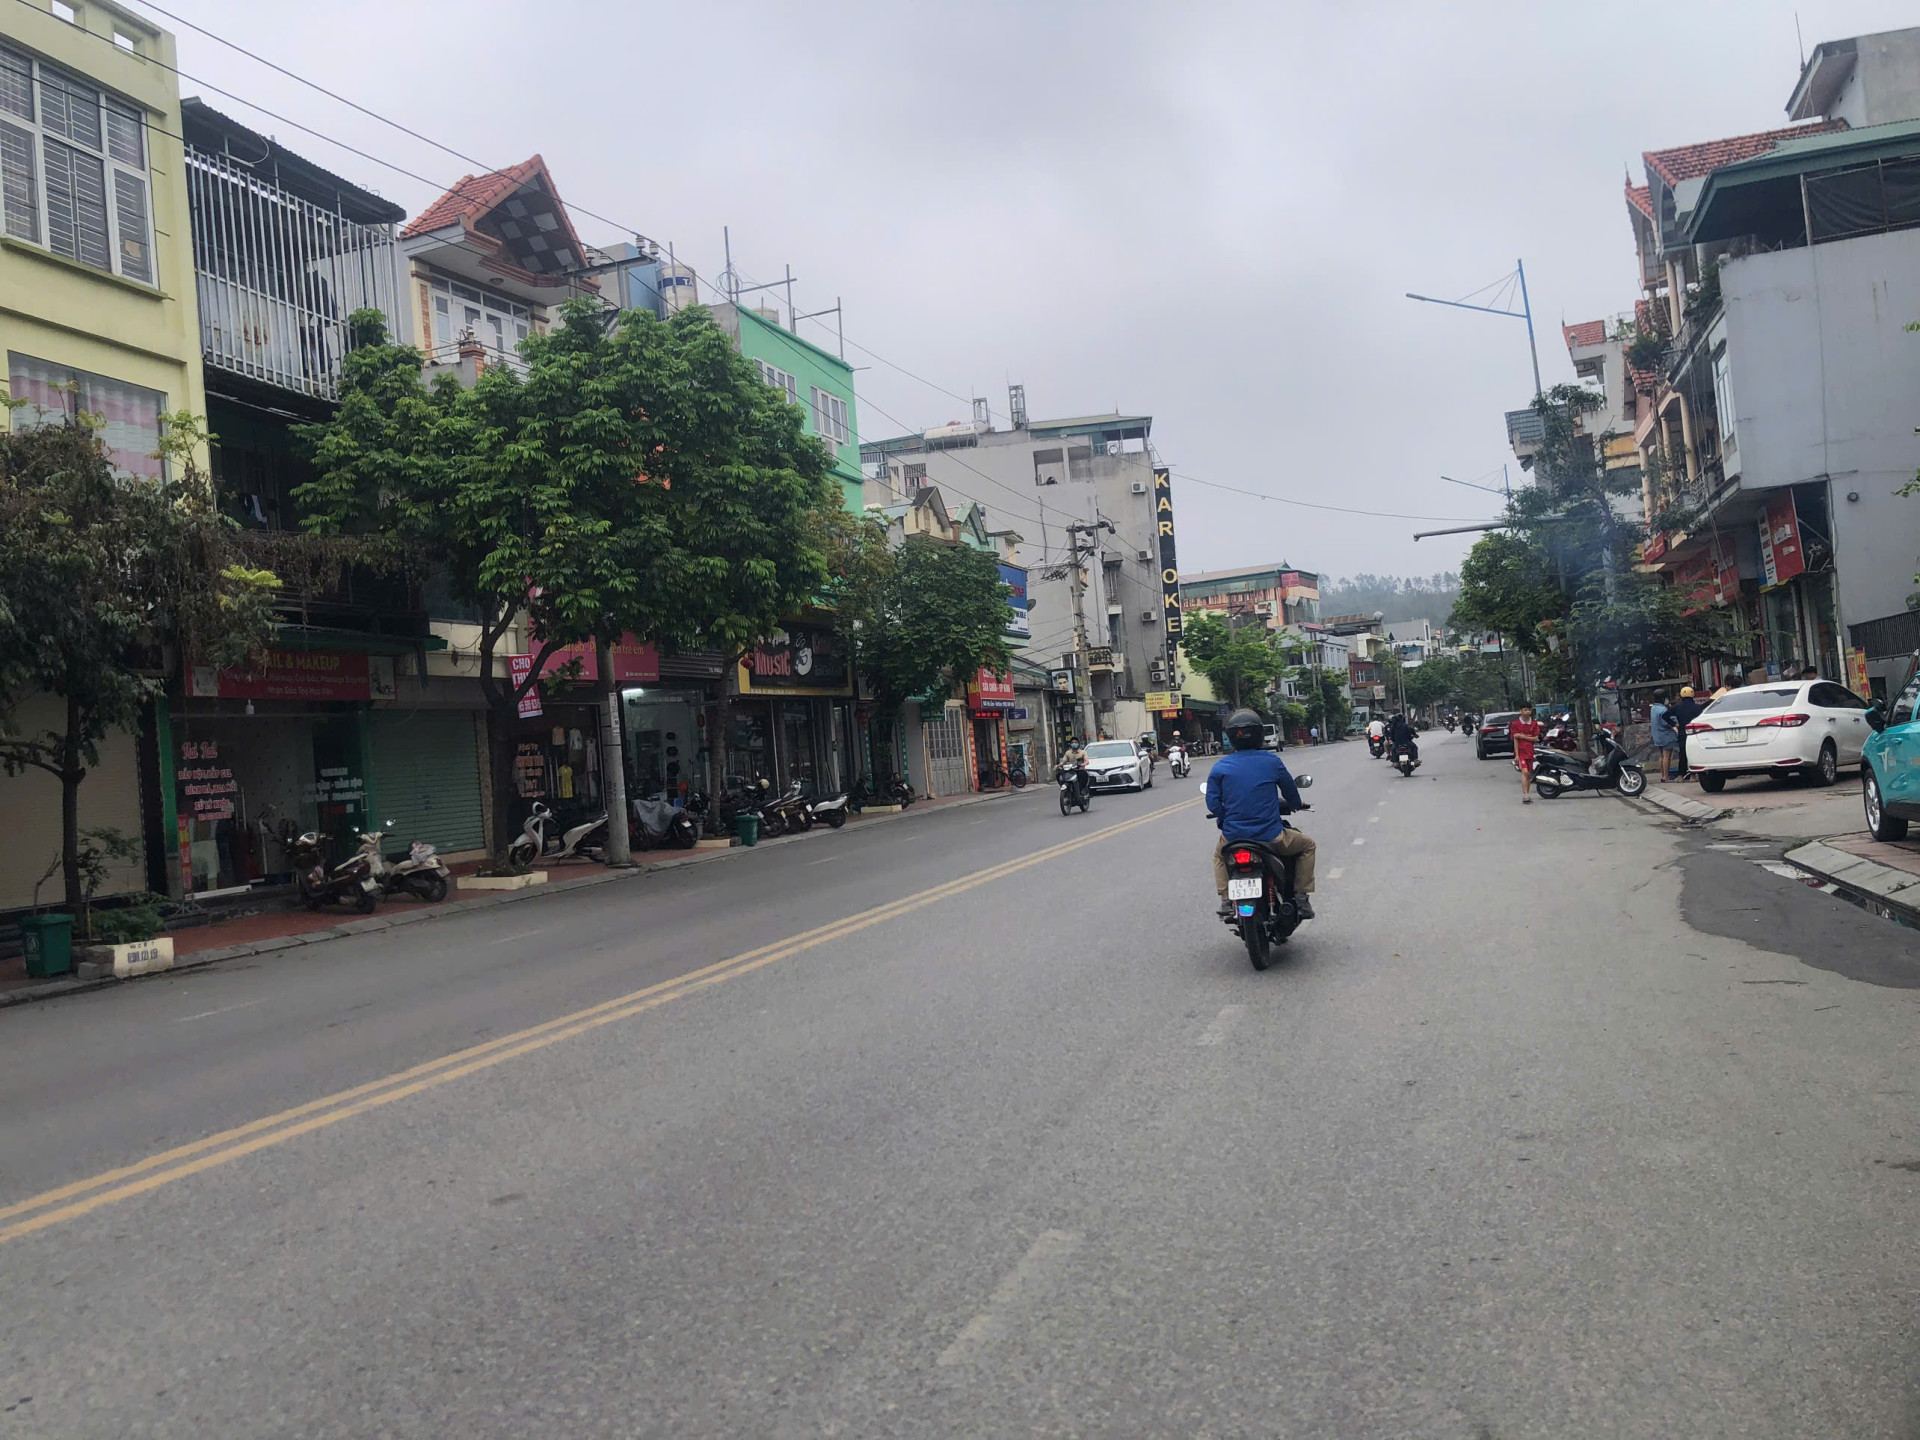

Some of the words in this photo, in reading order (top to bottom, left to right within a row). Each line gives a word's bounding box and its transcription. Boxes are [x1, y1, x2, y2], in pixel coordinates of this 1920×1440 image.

[1154, 472, 1181, 633] KAROKE
[297, 655, 340, 670] MAKEUP
[512, 656, 531, 670] CHO
[754, 649, 791, 677] MUSIC
[1232, 888, 1260, 898] 151.70
